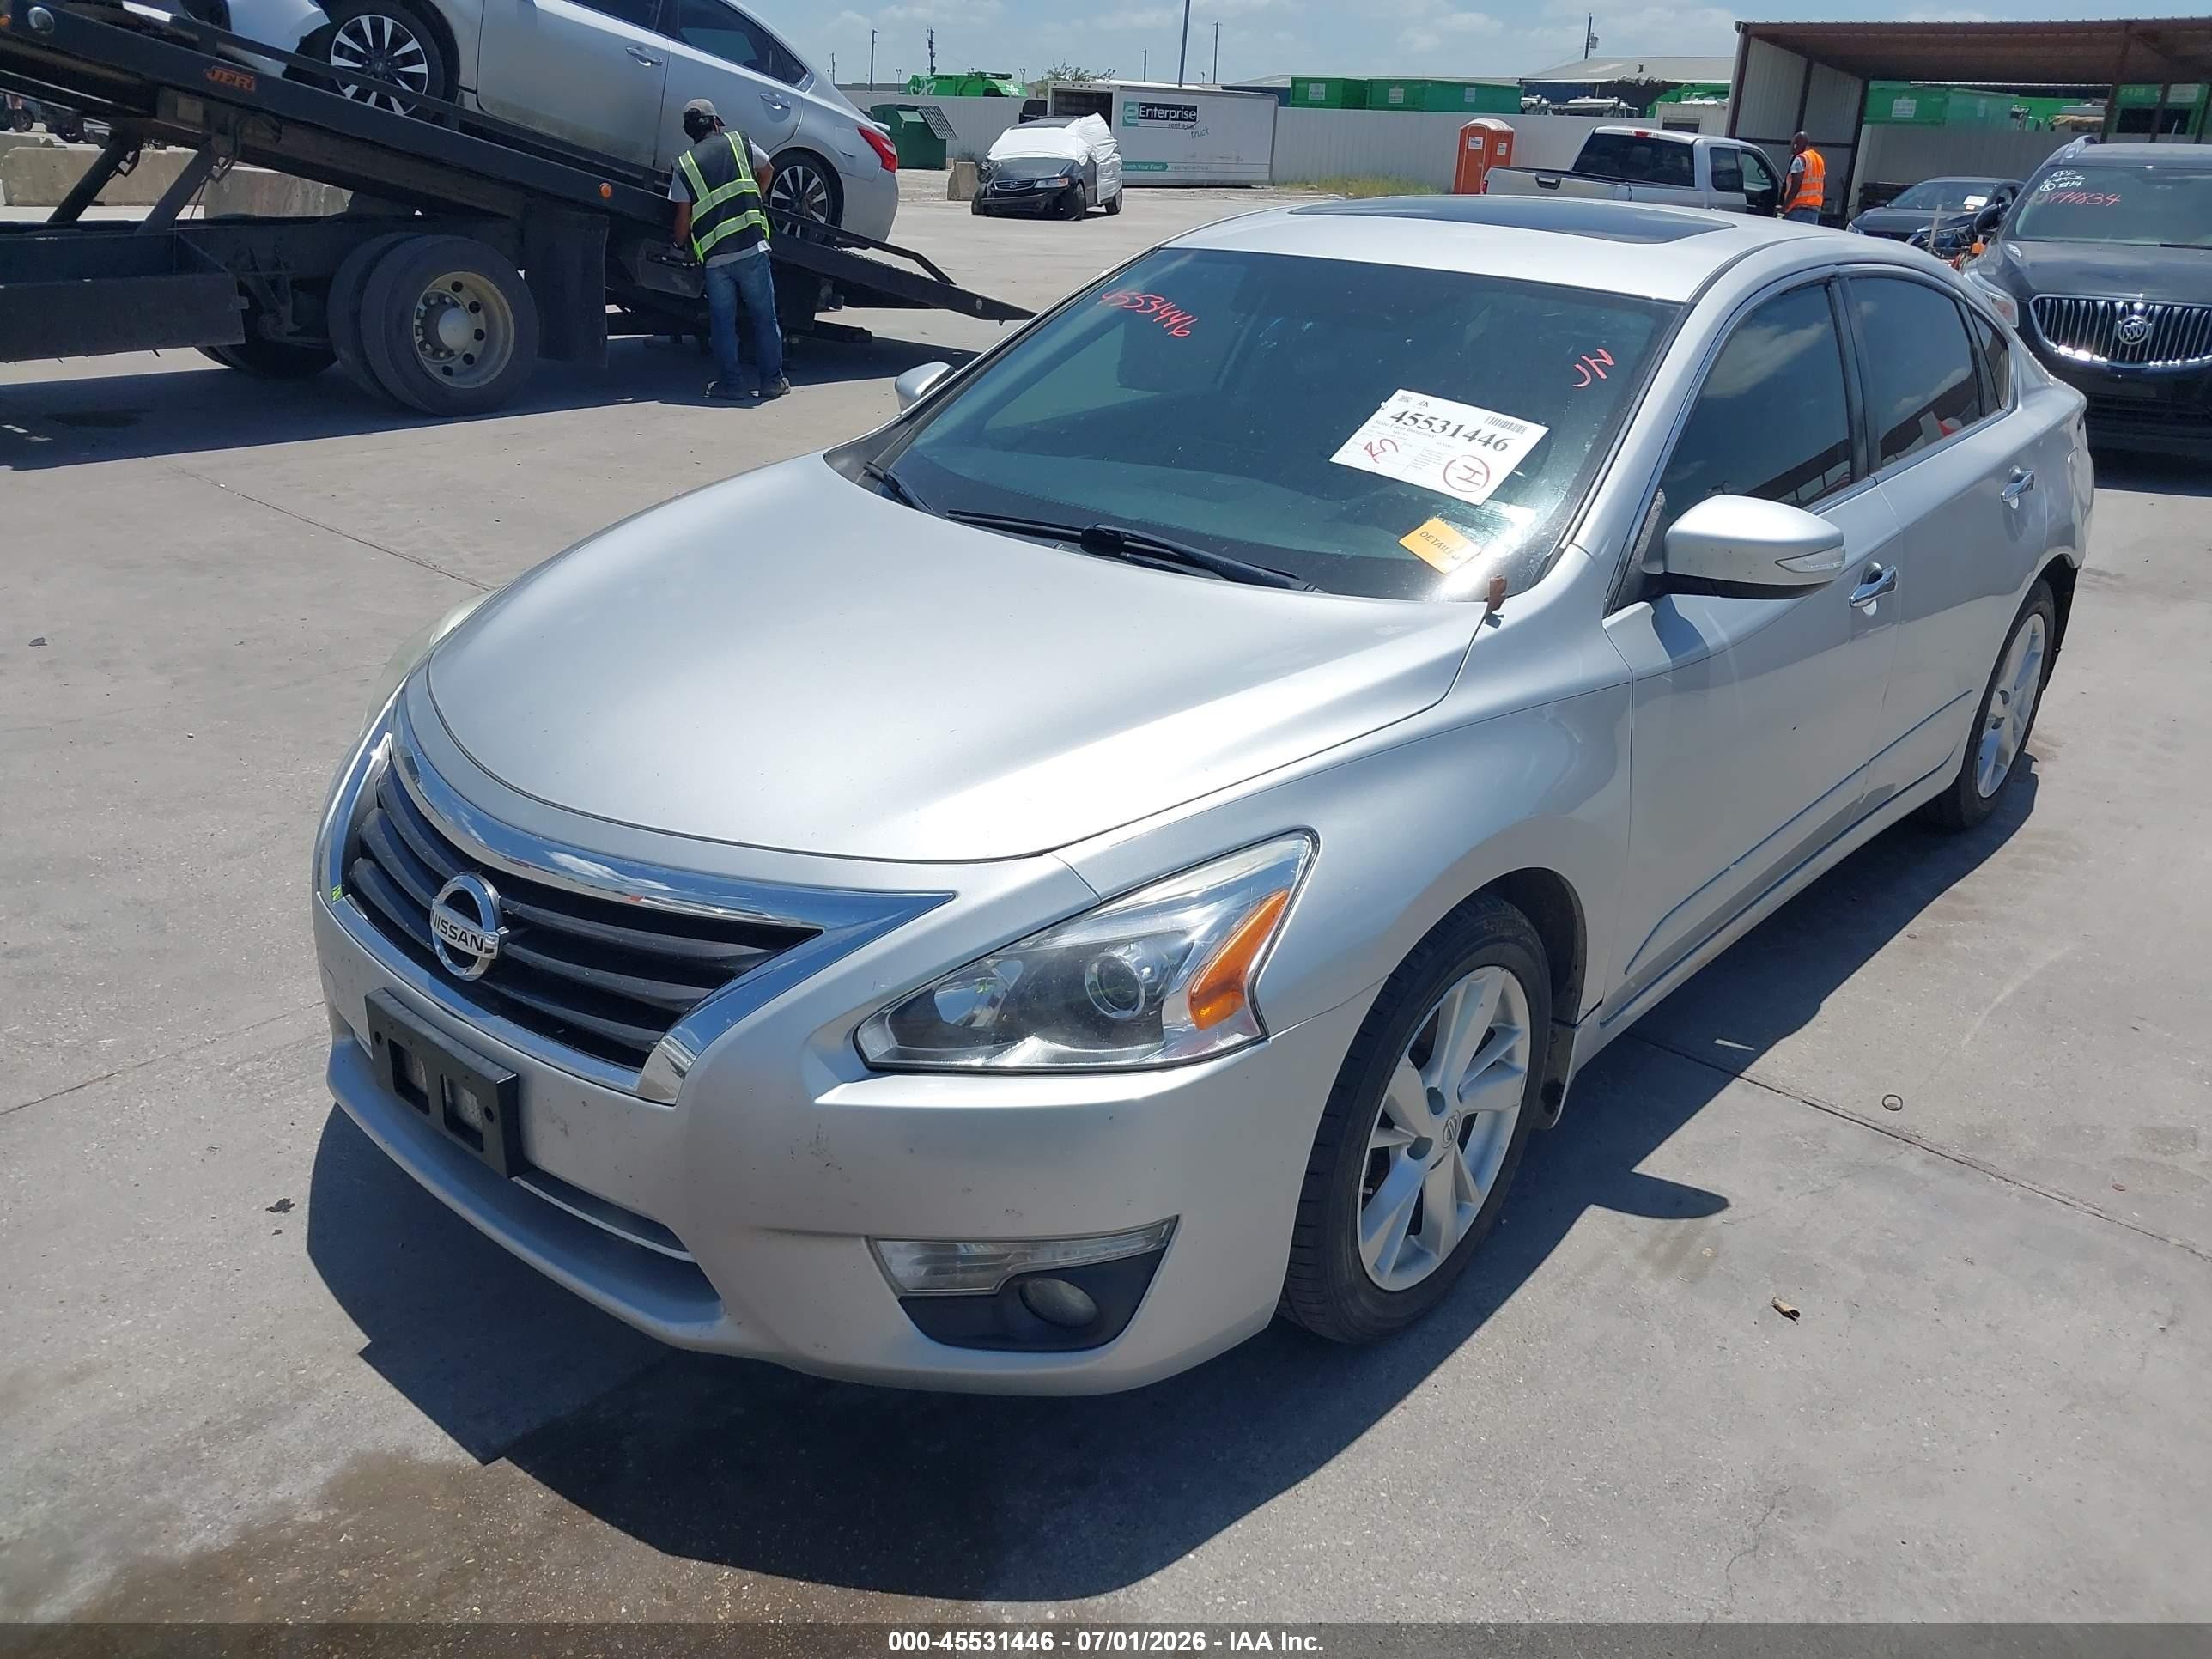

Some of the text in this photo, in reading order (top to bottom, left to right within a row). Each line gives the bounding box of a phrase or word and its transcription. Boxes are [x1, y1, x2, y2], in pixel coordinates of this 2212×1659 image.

[1139, 105, 1197, 121] Enterprise
[1389, 410, 1513, 452] 45531446
[430, 909, 484, 951] NISSAN
